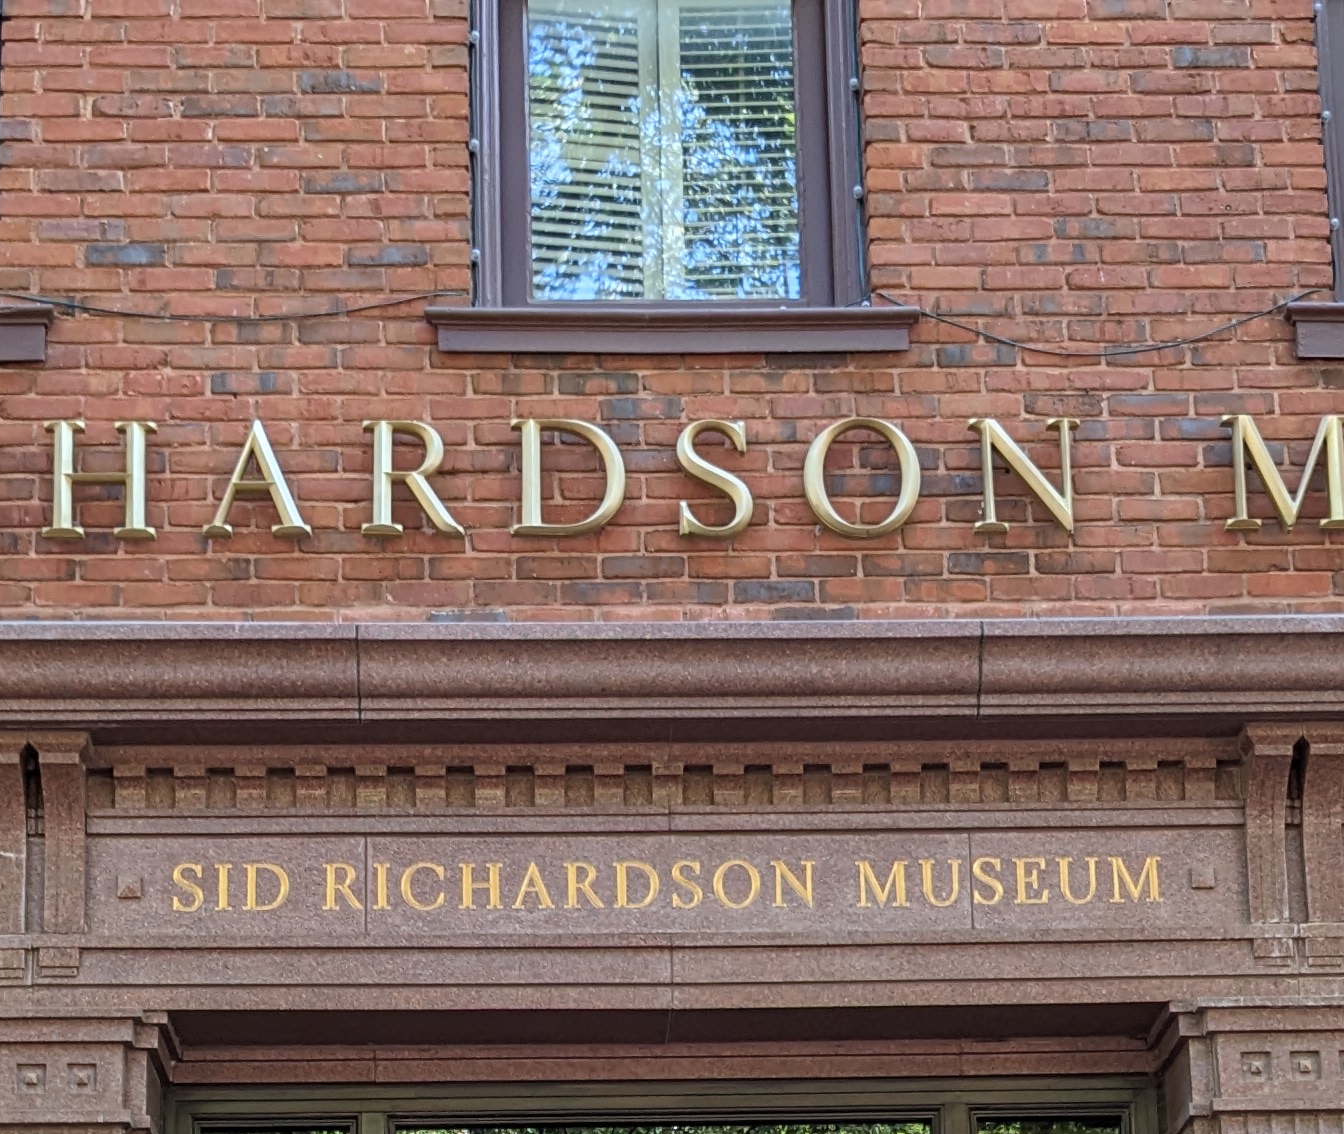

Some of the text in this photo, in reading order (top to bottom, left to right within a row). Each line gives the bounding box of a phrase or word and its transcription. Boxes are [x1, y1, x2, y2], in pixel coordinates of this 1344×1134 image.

[171, 855, 1165, 912] SID RICHARDSON MUSEUM
